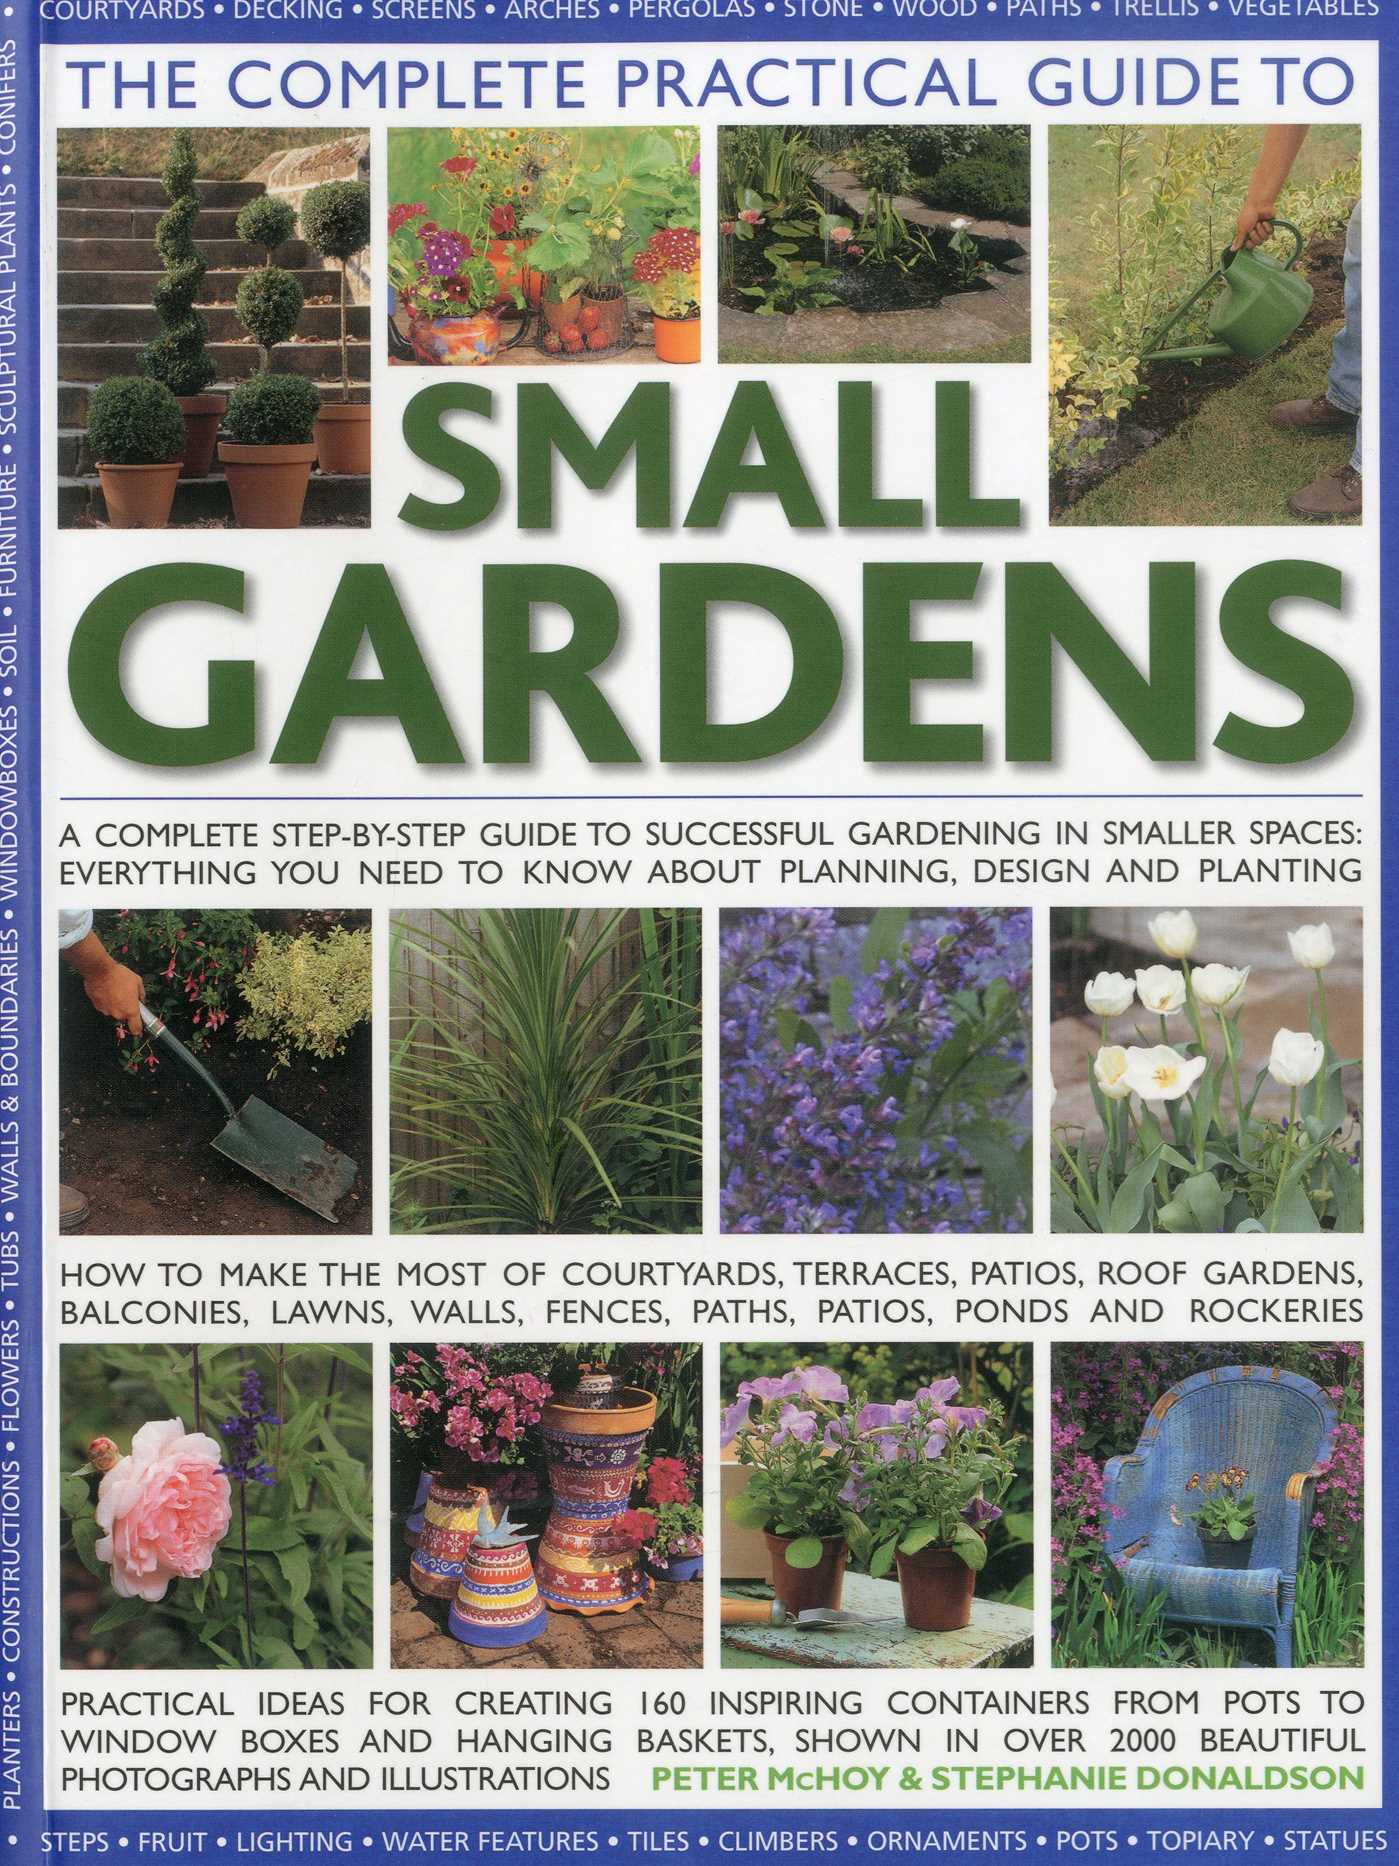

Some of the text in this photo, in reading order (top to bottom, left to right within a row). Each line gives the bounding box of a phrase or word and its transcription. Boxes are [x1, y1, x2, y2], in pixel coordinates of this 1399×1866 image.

[39, 0, 1379, 20] COURTYARDS DECKING SCREENS ARCHES PERGOLAS STONE WOOD PATHS TRELLIS VEGETABLES
[65, 56, 1355, 110] THE COMPLETE PRACTICAL GUIDE TO
[398, 381, 1020, 530] SMALL
[68, 559, 1354, 767] GARDENS
[58, 820, 1362, 848] A COMPLETE STEP-BY-STEP GUIDE TO SUCCESSFUL GARDENING IN SMALLER SPACES:
[60, 857, 1362, 887] EVERYTHING YOU NEED TO KNOW ABOUT PLANNING, DESIGN AND PLANTING
[0, 39, 21, 1810] PLANTERS CONSTRUCTIONS FLOWERS TUBS WALLS & BOUNDARIES WINDOWBOXES SOIL FURNITURE SCULPTURAL PLANTS CONIFERS
[61, 1260, 1363, 1289] HOW TO MAKE THE MOST OF COURTYARDS, TERRACES, PATIOS, ROOF GARDENS,
[61, 1298, 1364, 1329] BALCONIES, LAWNS, WALLS, FENCES, PATHS, PATIOS, PONDS AND ROCKERIES
[61, 1690, 1365, 1717] PRACTICAL IDEAS FOR CREATING 160 INSPIRING CONTAINERS FROM POTS TO
[60, 1727, 1367, 1756] WINDOW BOXES AND HANGING BASKETS, SHOWN IN OVER 2000 BEAUTIFUL
[62, 1766, 610, 1792] PHOTOGRAPHS AND ILLUSTRATIONS
[652, 1765, 1365, 1792] PETER McHOY & STEPHANIE DONALDSON
[41, 1830, 1388, 1852] STEPS FRUIT LIGHTING WATER FEATURES TILES CLIMBERS ORNAMENTS POTS TOPIARY STATUES
